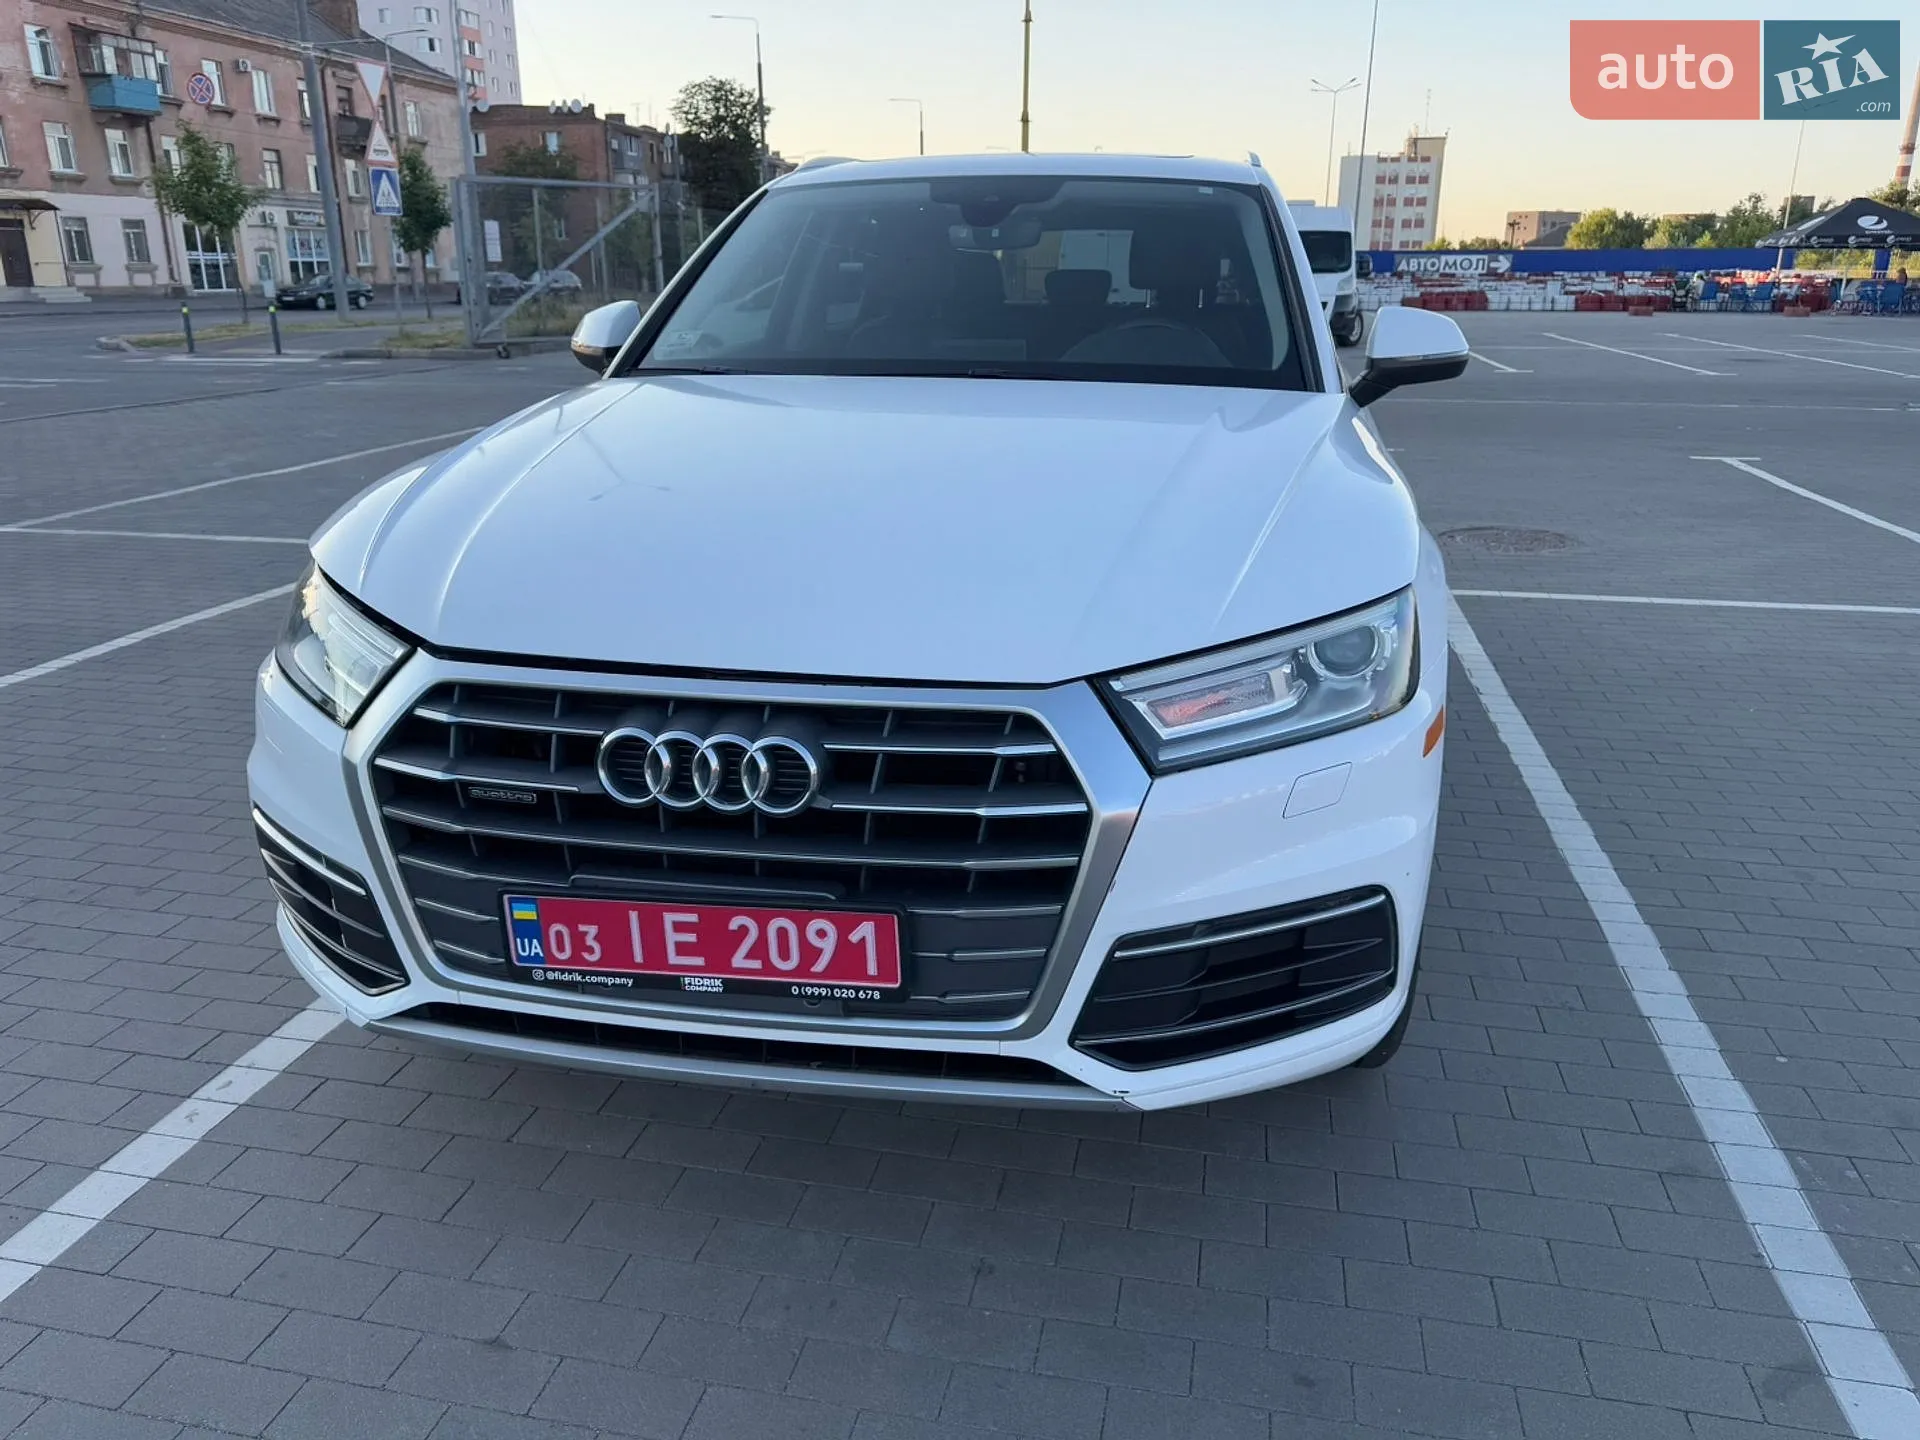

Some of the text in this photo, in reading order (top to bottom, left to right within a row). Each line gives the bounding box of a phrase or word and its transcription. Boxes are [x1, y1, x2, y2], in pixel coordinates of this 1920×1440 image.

[516, 938, 544, 957] UA
[548, 923, 601, 962] 03
[727, 915, 880, 976] 2091
[546, 970, 634, 987] @fidrik.company
[683, 976, 723, 987] FIDRIK
[684, 985, 724, 994] COMPANY
[791, 985, 881, 1000] 0 (999) 020 678
